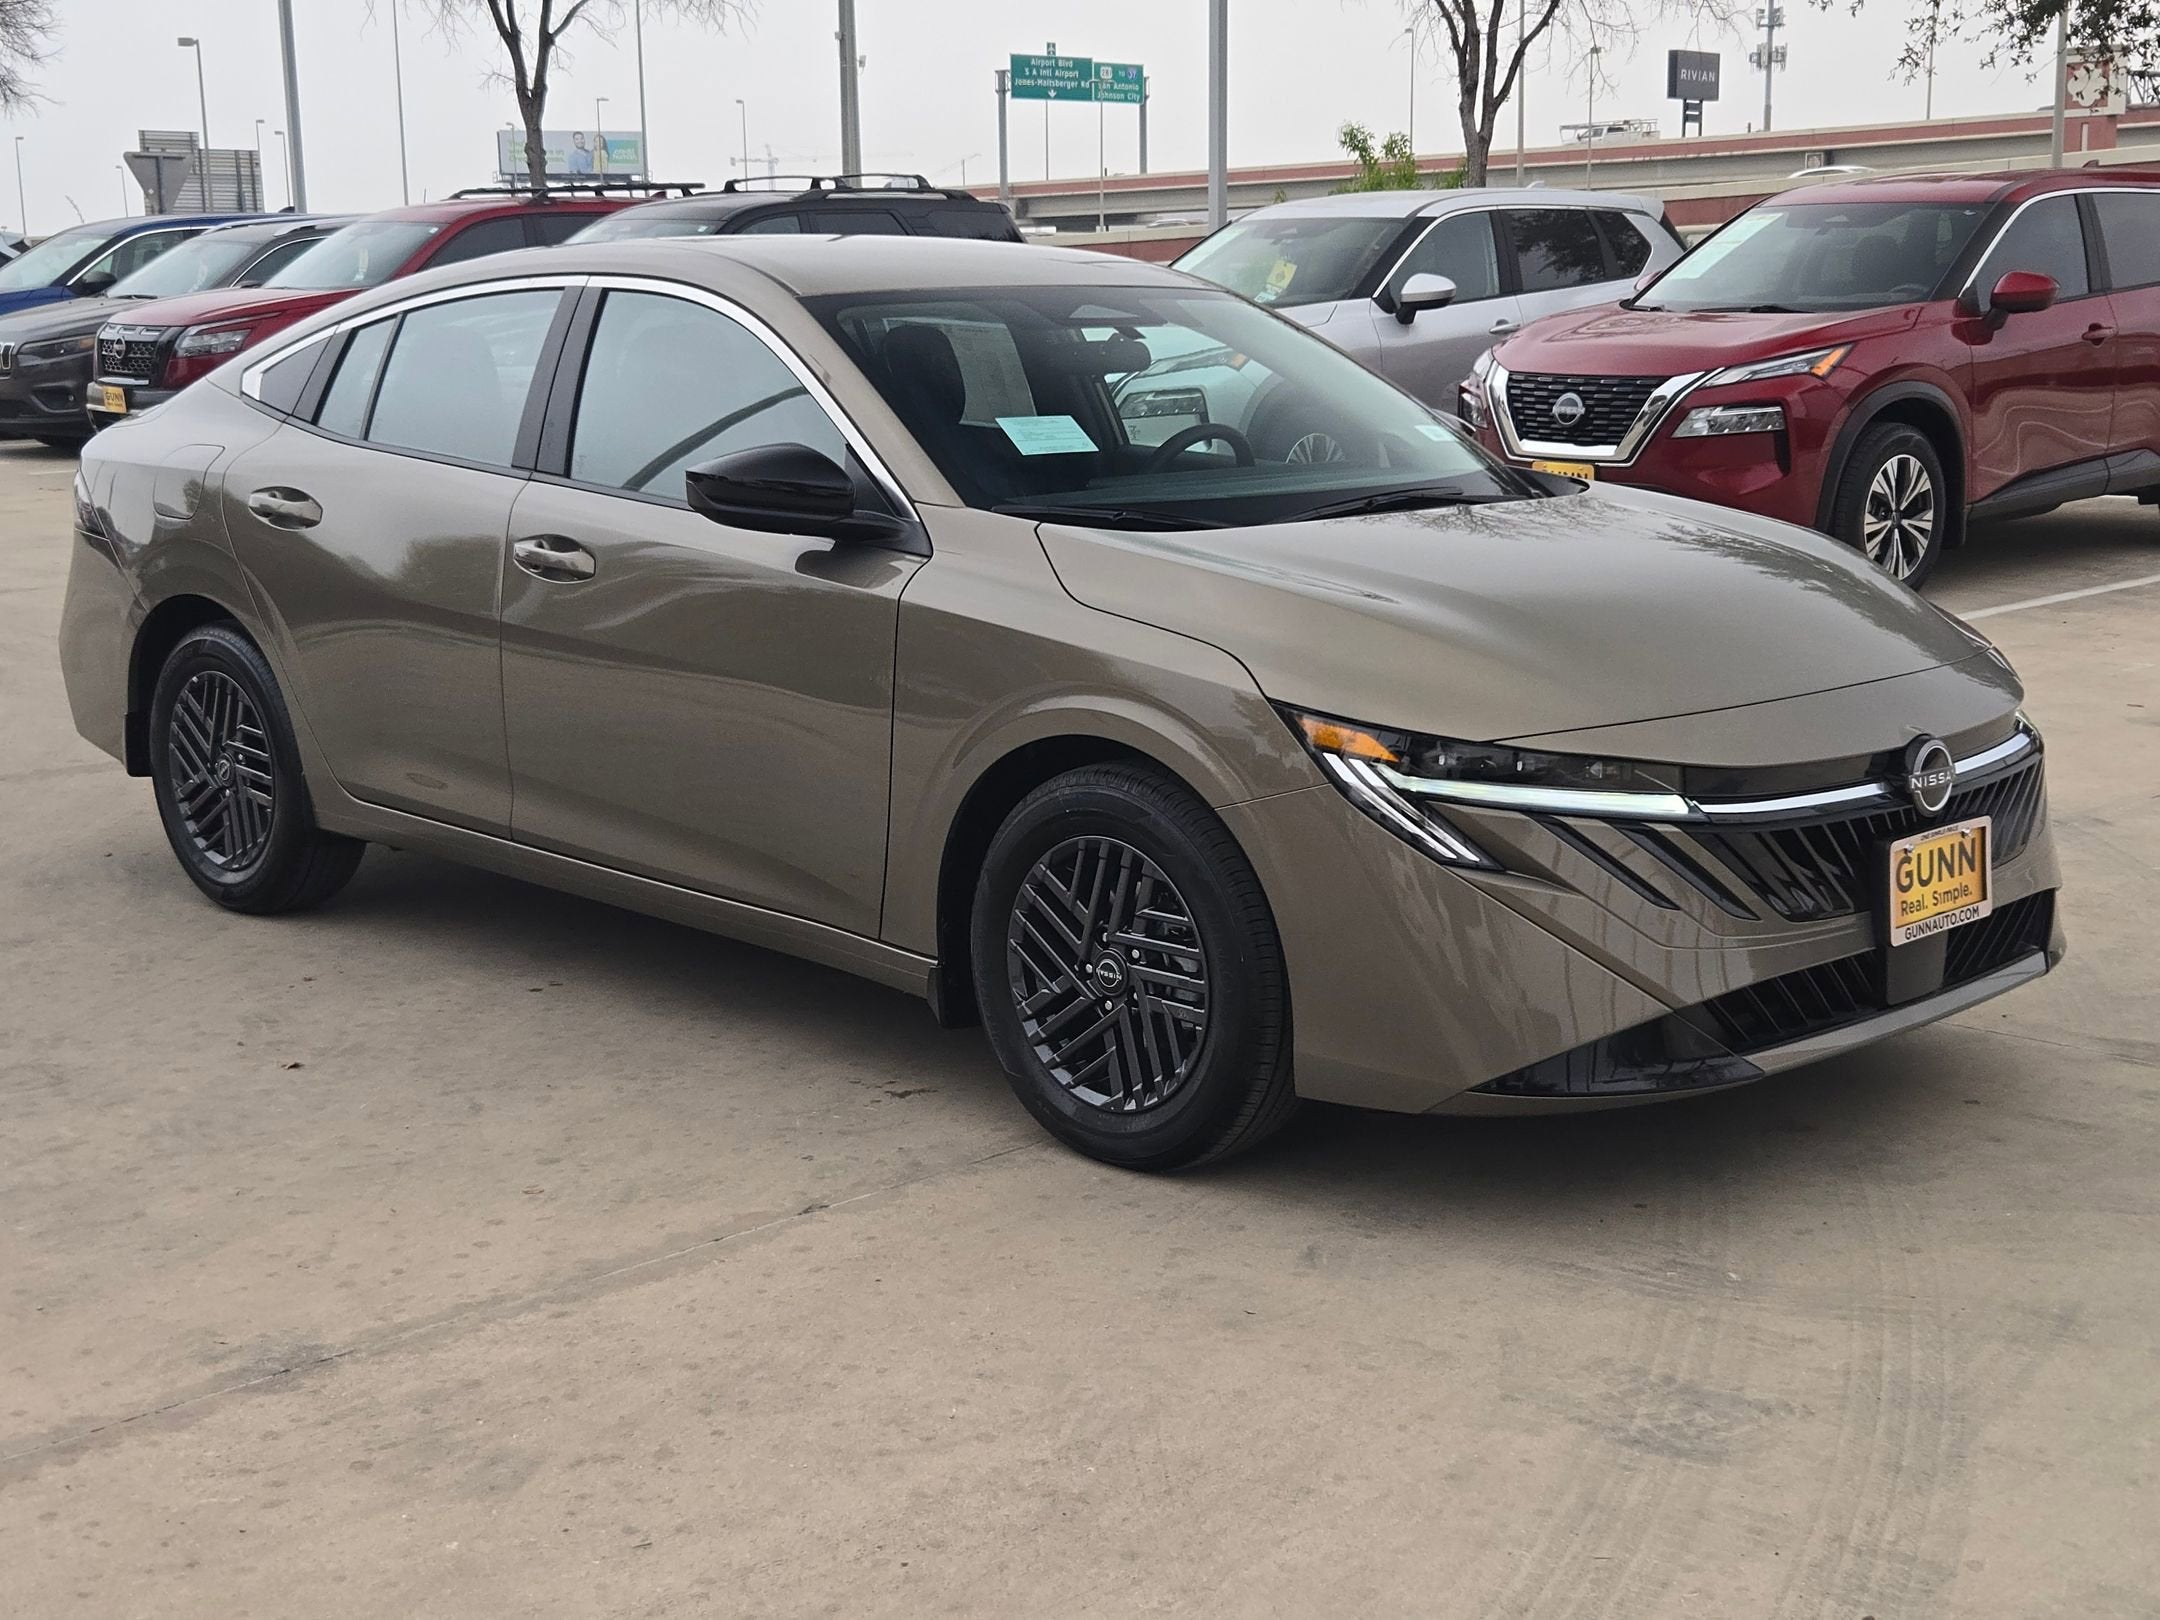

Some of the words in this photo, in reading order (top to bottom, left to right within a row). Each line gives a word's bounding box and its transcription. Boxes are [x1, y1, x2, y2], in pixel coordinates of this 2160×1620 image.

[1031, 58, 1056, 68] Airport
[1058, 59, 1073, 68] Blvd
[1032, 68, 1037, 76] A
[1055, 69, 1079, 79] Airport
[1680, 69, 1715, 82] RIVIAN
[1015, 78, 1078, 89] Jones-Maltsberger
[1081, 80, 1090, 88] Rd
[1114, 82, 1139, 90] Antonio
[1127, 92, 1140, 102] City
[1896, 837, 1976, 893] GUNN
[1901, 894, 1928, 917] Real.
[1932, 882, 1973, 907] Simple.
[1905, 905, 1980, 940] GUNNAUTO.COM
